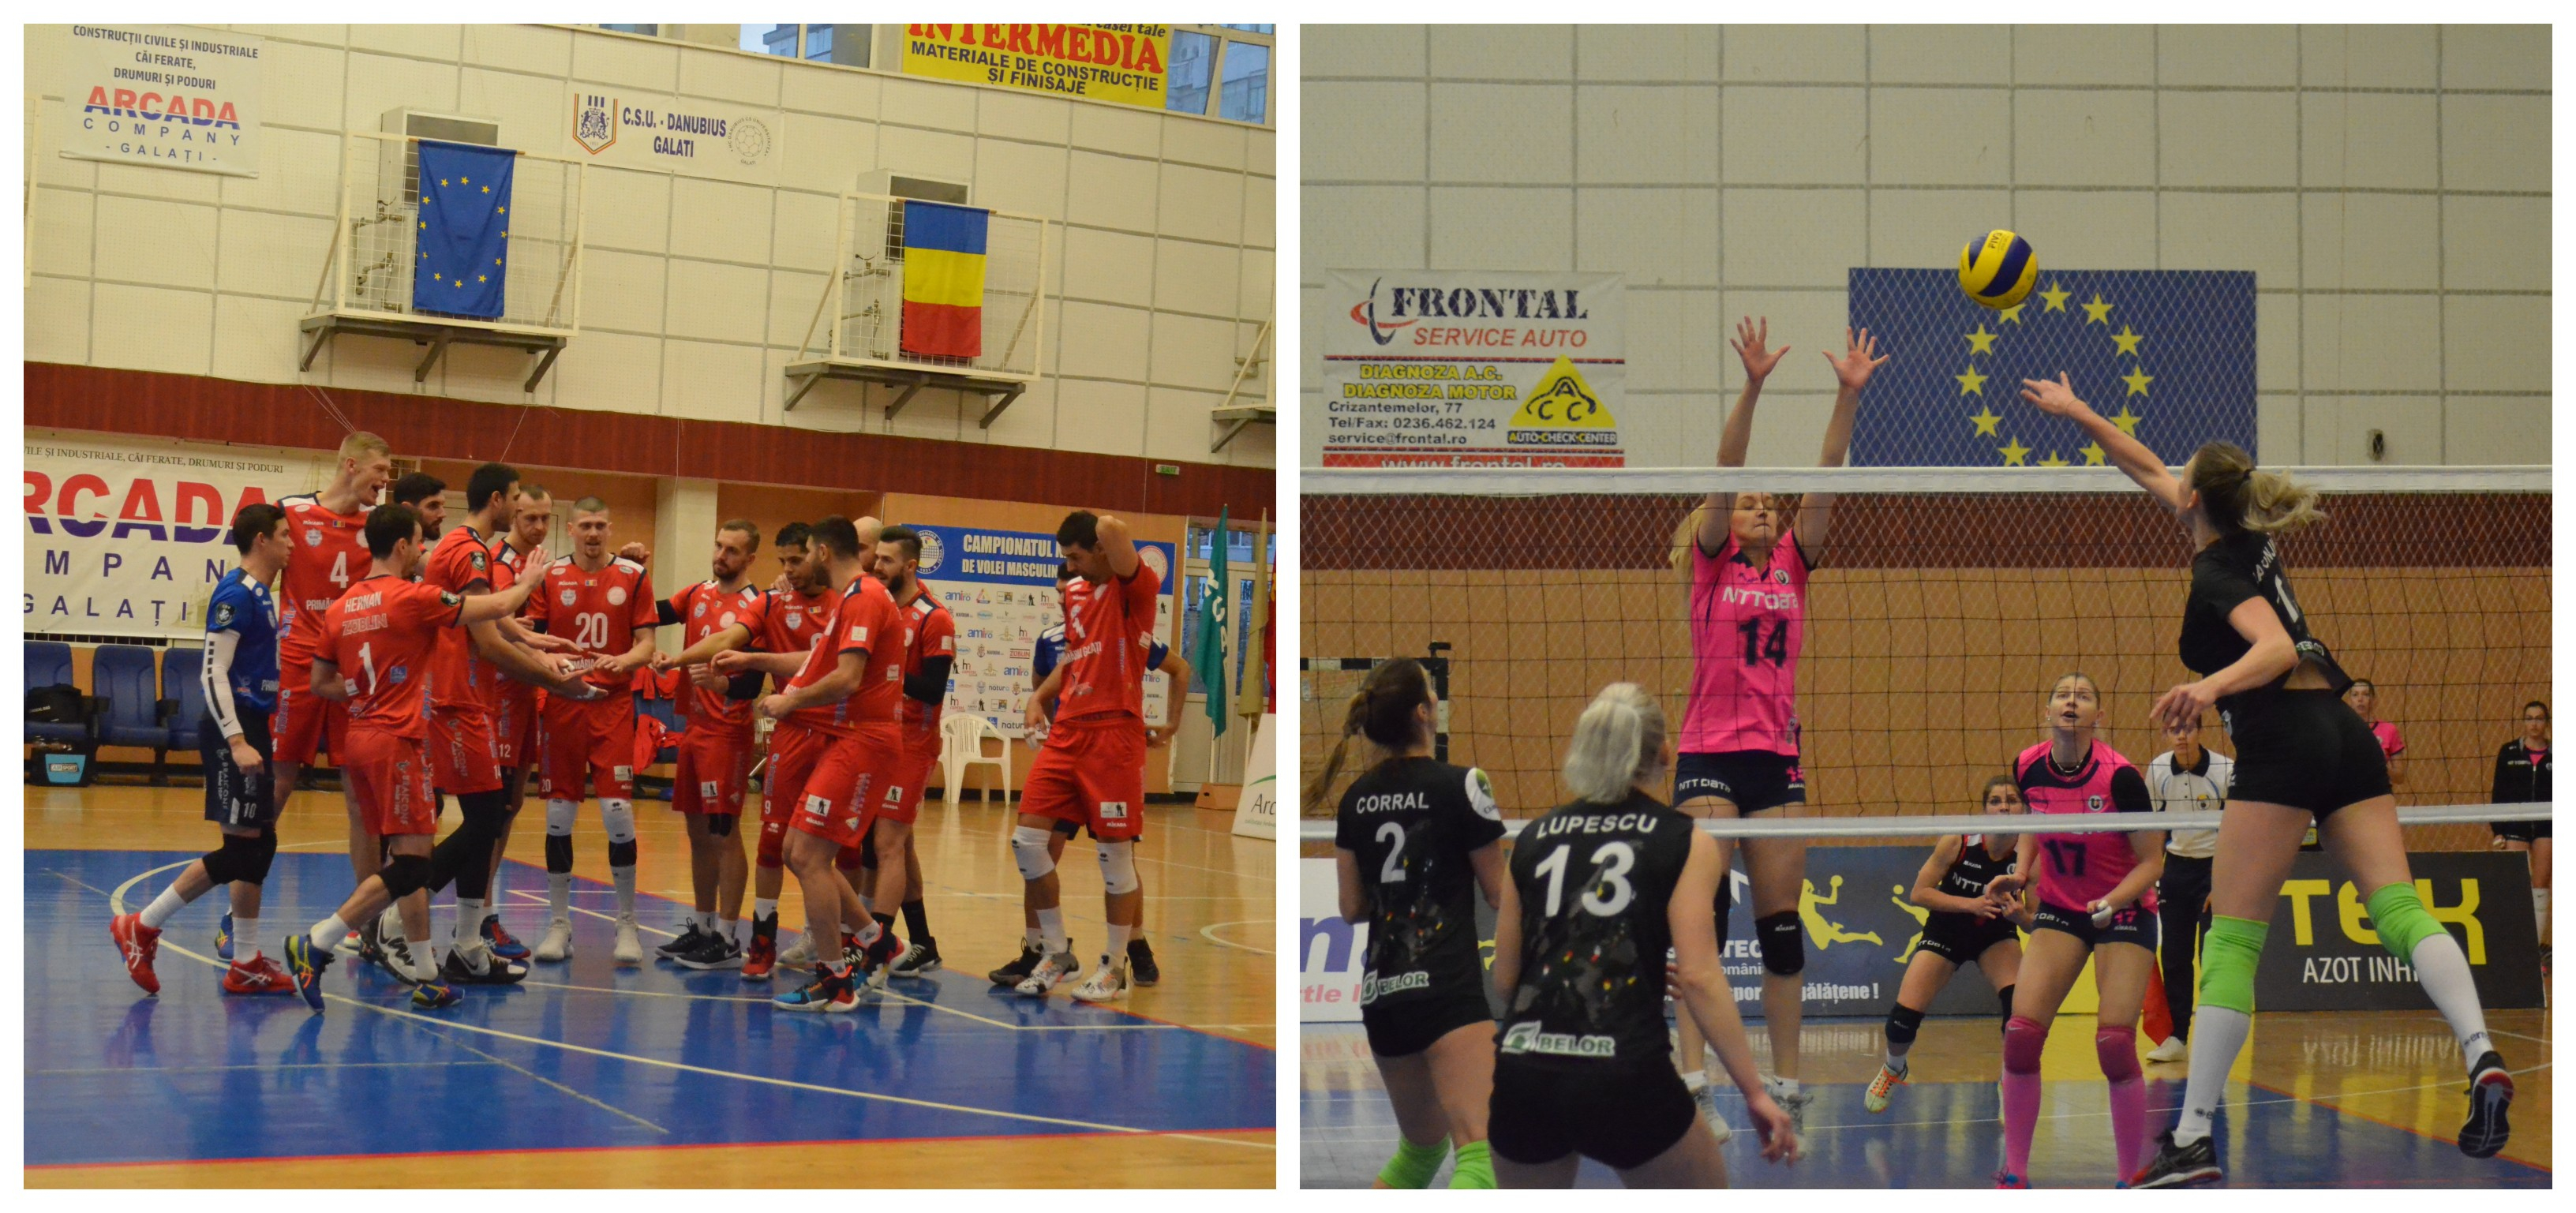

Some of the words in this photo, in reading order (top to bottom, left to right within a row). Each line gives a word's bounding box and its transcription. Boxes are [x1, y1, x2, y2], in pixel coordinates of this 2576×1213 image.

[73, 25, 141, 46] CONSTRUCȚII
[144, 35, 176, 48] CIVILE
[191, 41, 258, 58] INDUSTRIALE
[1137, 24, 1166, 38] tale
[135, 51, 152, 63] CĂI
[155, 54, 196, 69] FERATE,
[912, 41, 1010, 68] MATERIALE
[1016, 58, 1037, 73] DE
[1043, 62, 1159, 92] CONSTRUCȚIE
[114, 68, 162, 83] DRUMURI
[177, 76, 215, 89] PODURI
[1010, 70, 1086, 95] FINISAJE
[84, 85, 240, 130] ARCADA
[84, 118, 240, 146] COMPANY
[623, 107, 656, 128] C.S.U.
[667, 114, 727, 137] DANUBIUS
[653, 136, 694, 158] GALATI
[1391, 287, 1588, 319] FRONTAL
[1414, 328, 1517, 347] SERVICE
[1520, 328, 1587, 348] AUTO
[1360, 365, 1460, 380] DIAGNOZA
[1464, 365, 1503, 380] A.C.
[1343, 383, 1444, 399] DIAGNOZA
[1448, 384, 1517, 400] MOTOR
[1328, 401, 1440, 415] Crizantemelor,
[1445, 402, 1462, 414] 77
[1329, 417, 1389, 429] Tel/Fax:
[1393, 417, 1496, 429] 0236.462.124
[1328, 432, 1467, 446] service@frontal.ro
[58, 448, 125, 462] INDUSTRIALE,
[128, 453, 144, 462] CĂI
[146, 455, 185, 466] FERATE,
[189, 458, 234, 470] DRUMURI
[248, 463, 283, 474] PODURI
[963, 534, 1053, 558] CAMPIONATUL
[330, 551, 349, 589] 4
[961, 558, 975, 574] DE
[977, 560, 1005, 575] VOLEI
[1007, 563, 1058, 578] MASCULIN
[344, 591, 382, 613] HERNAN
[575, 612, 608, 649] 20
[1739, 617, 1788, 668] 14
[358, 642, 376, 694] 1
[499, 743, 511, 758] 12
[244, 803, 256, 818] 10
[765, 800, 771, 814] 9
[1356, 792, 1429, 814] CORRAL
[1537, 814, 1658, 840] LUPESCU
[1375, 822, 1406, 883] 2
[2044, 839, 2086, 876] 17
[1534, 840, 1635, 917] 13
[1953, 871, 1982, 893] NTT
[2303, 957, 2361, 983] AZOT
[1380, 972, 1428, 994] BELOR
[1538, 1035, 1615, 1056] BELOR
